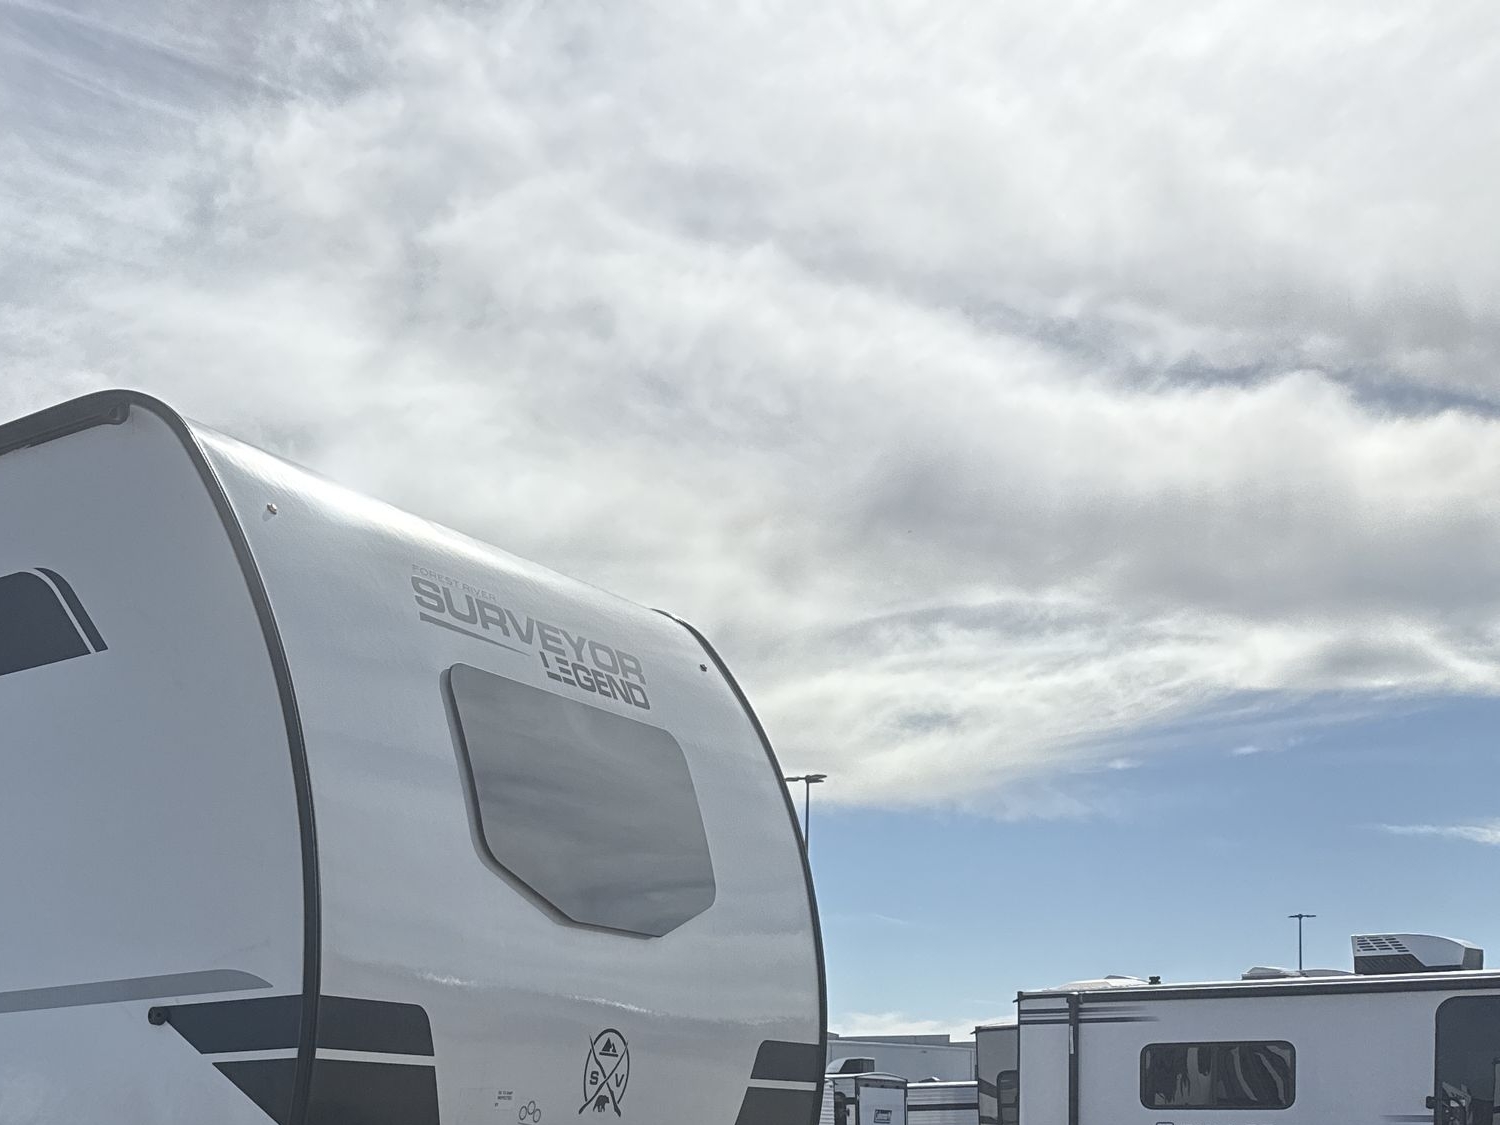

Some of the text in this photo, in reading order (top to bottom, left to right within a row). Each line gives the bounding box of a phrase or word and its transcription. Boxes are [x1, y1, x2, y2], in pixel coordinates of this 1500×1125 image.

[411, 563, 497, 601] FOREST RIVER
[410, 576, 647, 686] SURVEYOR
[539, 651, 651, 711] LEGEND
[589, 1070, 625, 1087] S V
